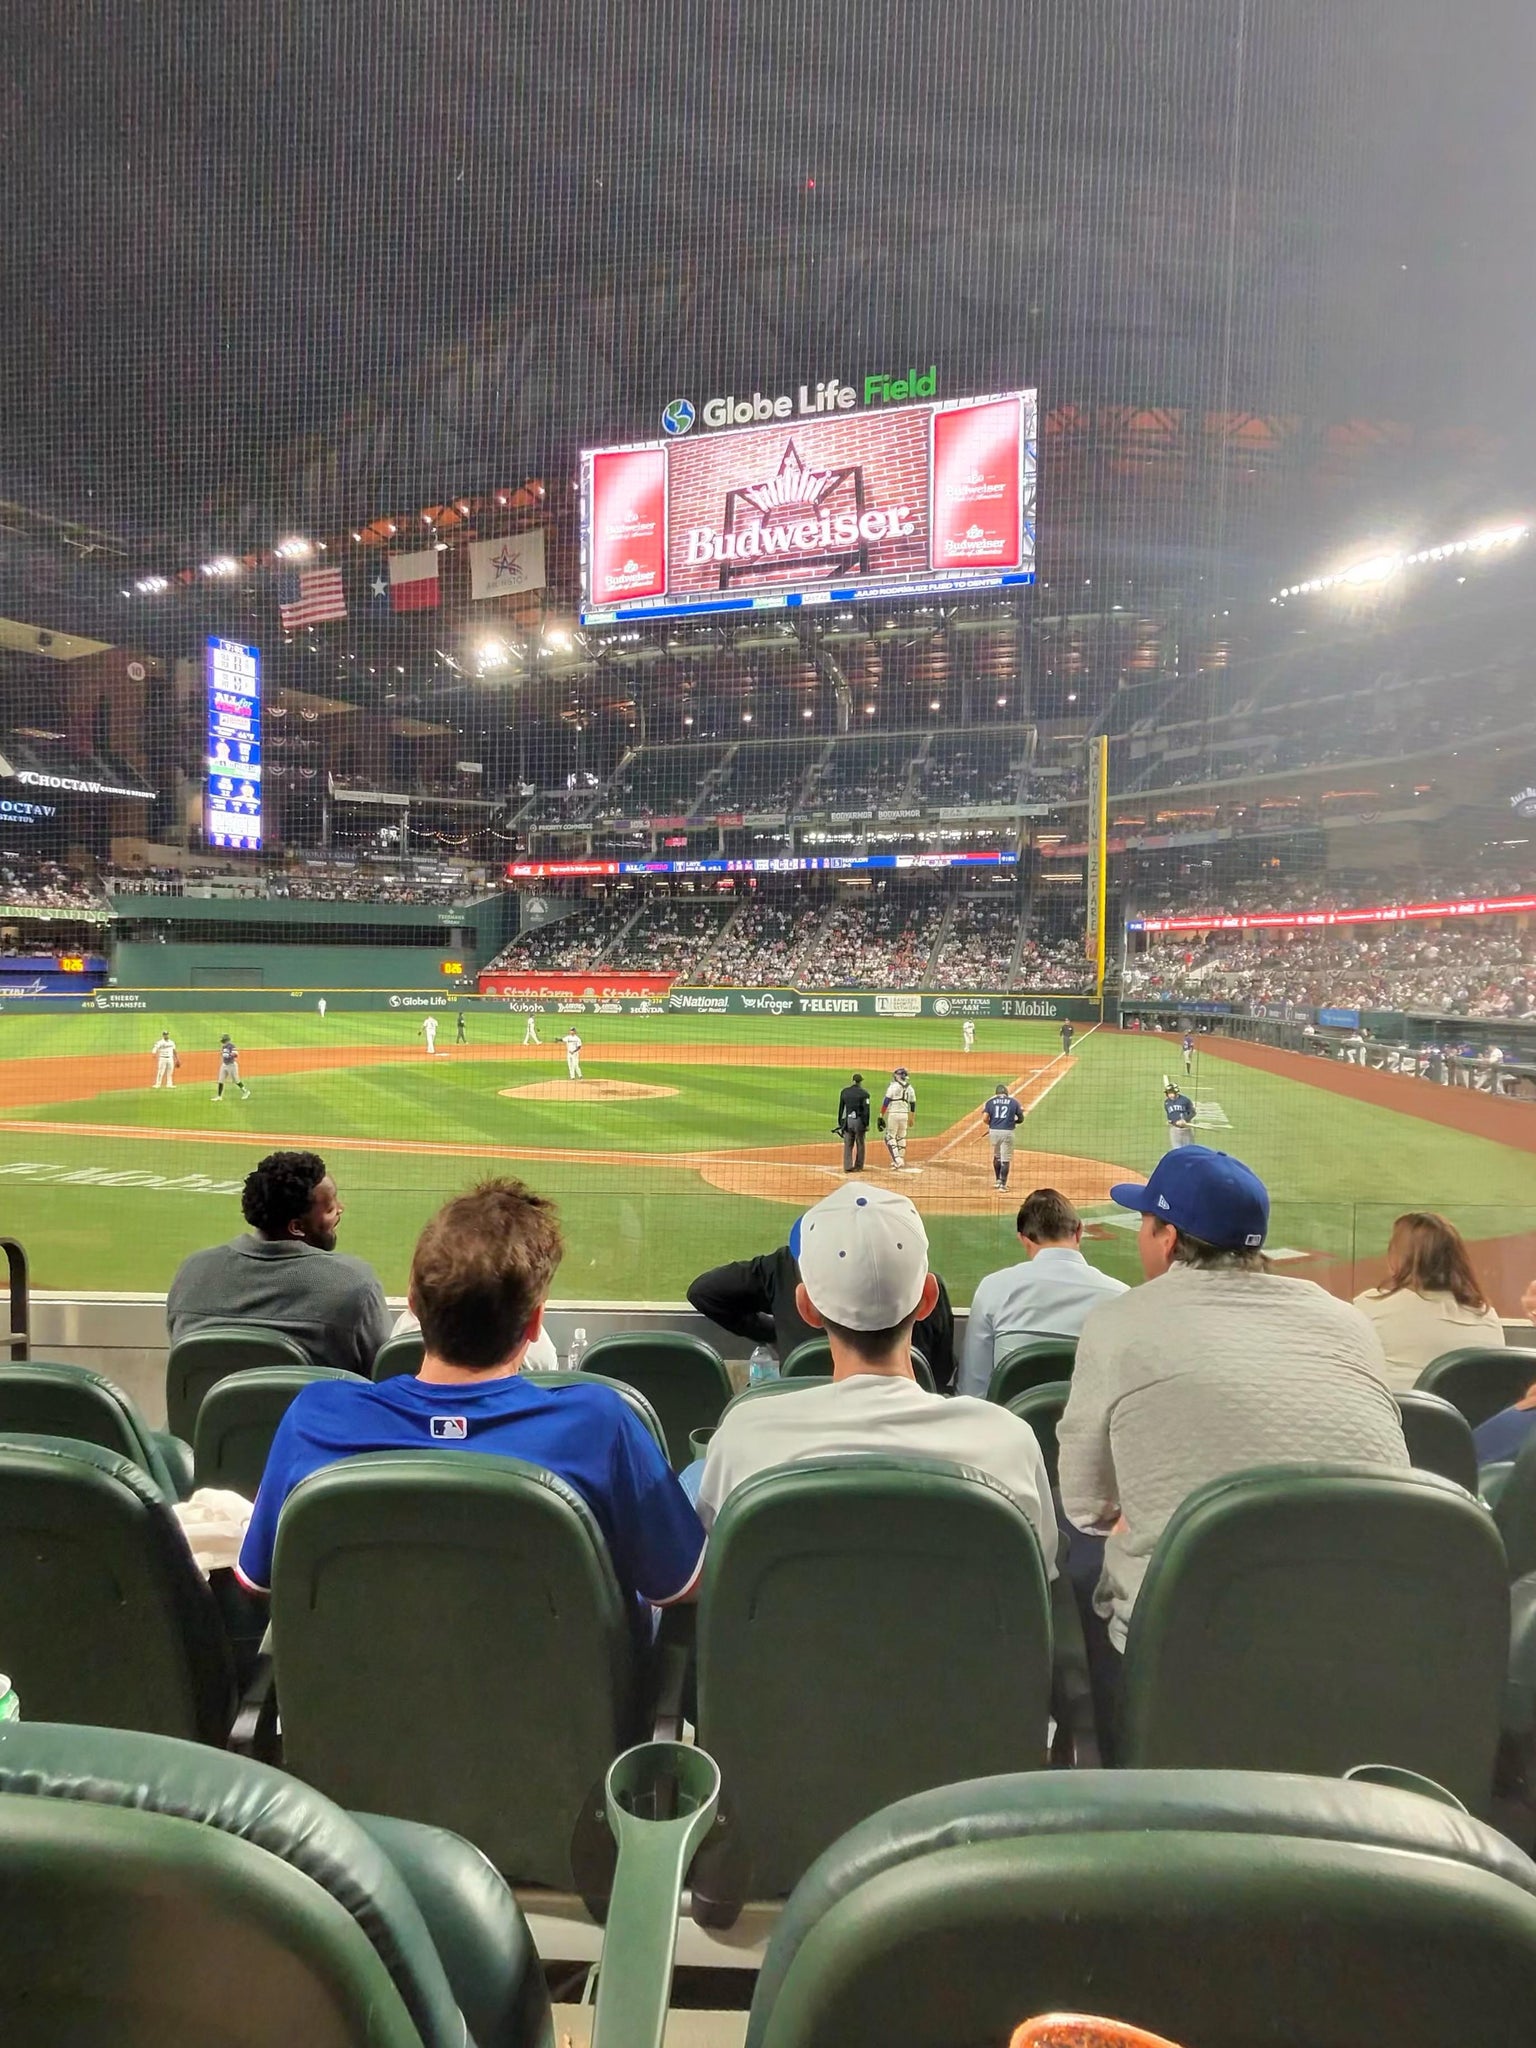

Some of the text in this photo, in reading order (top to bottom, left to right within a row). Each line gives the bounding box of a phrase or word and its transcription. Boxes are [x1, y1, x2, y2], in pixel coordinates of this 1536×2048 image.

[703, 366, 936, 427] Globe Life Field
[685, 506, 911, 565] Budweiser
[944, 539, 1006, 551] Budweiser
[605, 571, 656, 584] Budweiser
[953, 580, 966, 588] TO
[966, 578, 1002, 588] CENTER
[131, 666, 142, 677] 10
[28, 771, 101, 793] CHOCTAW
[831, 811, 873, 821] BODYARMOR
[878, 809, 921, 820] BODYARMOR
[538, 823, 562, 831] PRIORITY
[1090, 883, 1098, 931] FARE
[44, 909, 106, 923] STAFFING
[402, 997, 447, 1006] Globe Life
[510, 1002, 545, 1013] Kubota
[683, 995, 729, 1008] National
[757, 994, 793, 1015] Kroger
[799, 999, 859, 1013] 7-ELEVEN
[877, 997, 889, 1010] T
[1015, 1000, 1057, 1017] Mobile
[994, 1105, 1008, 1119] 12
